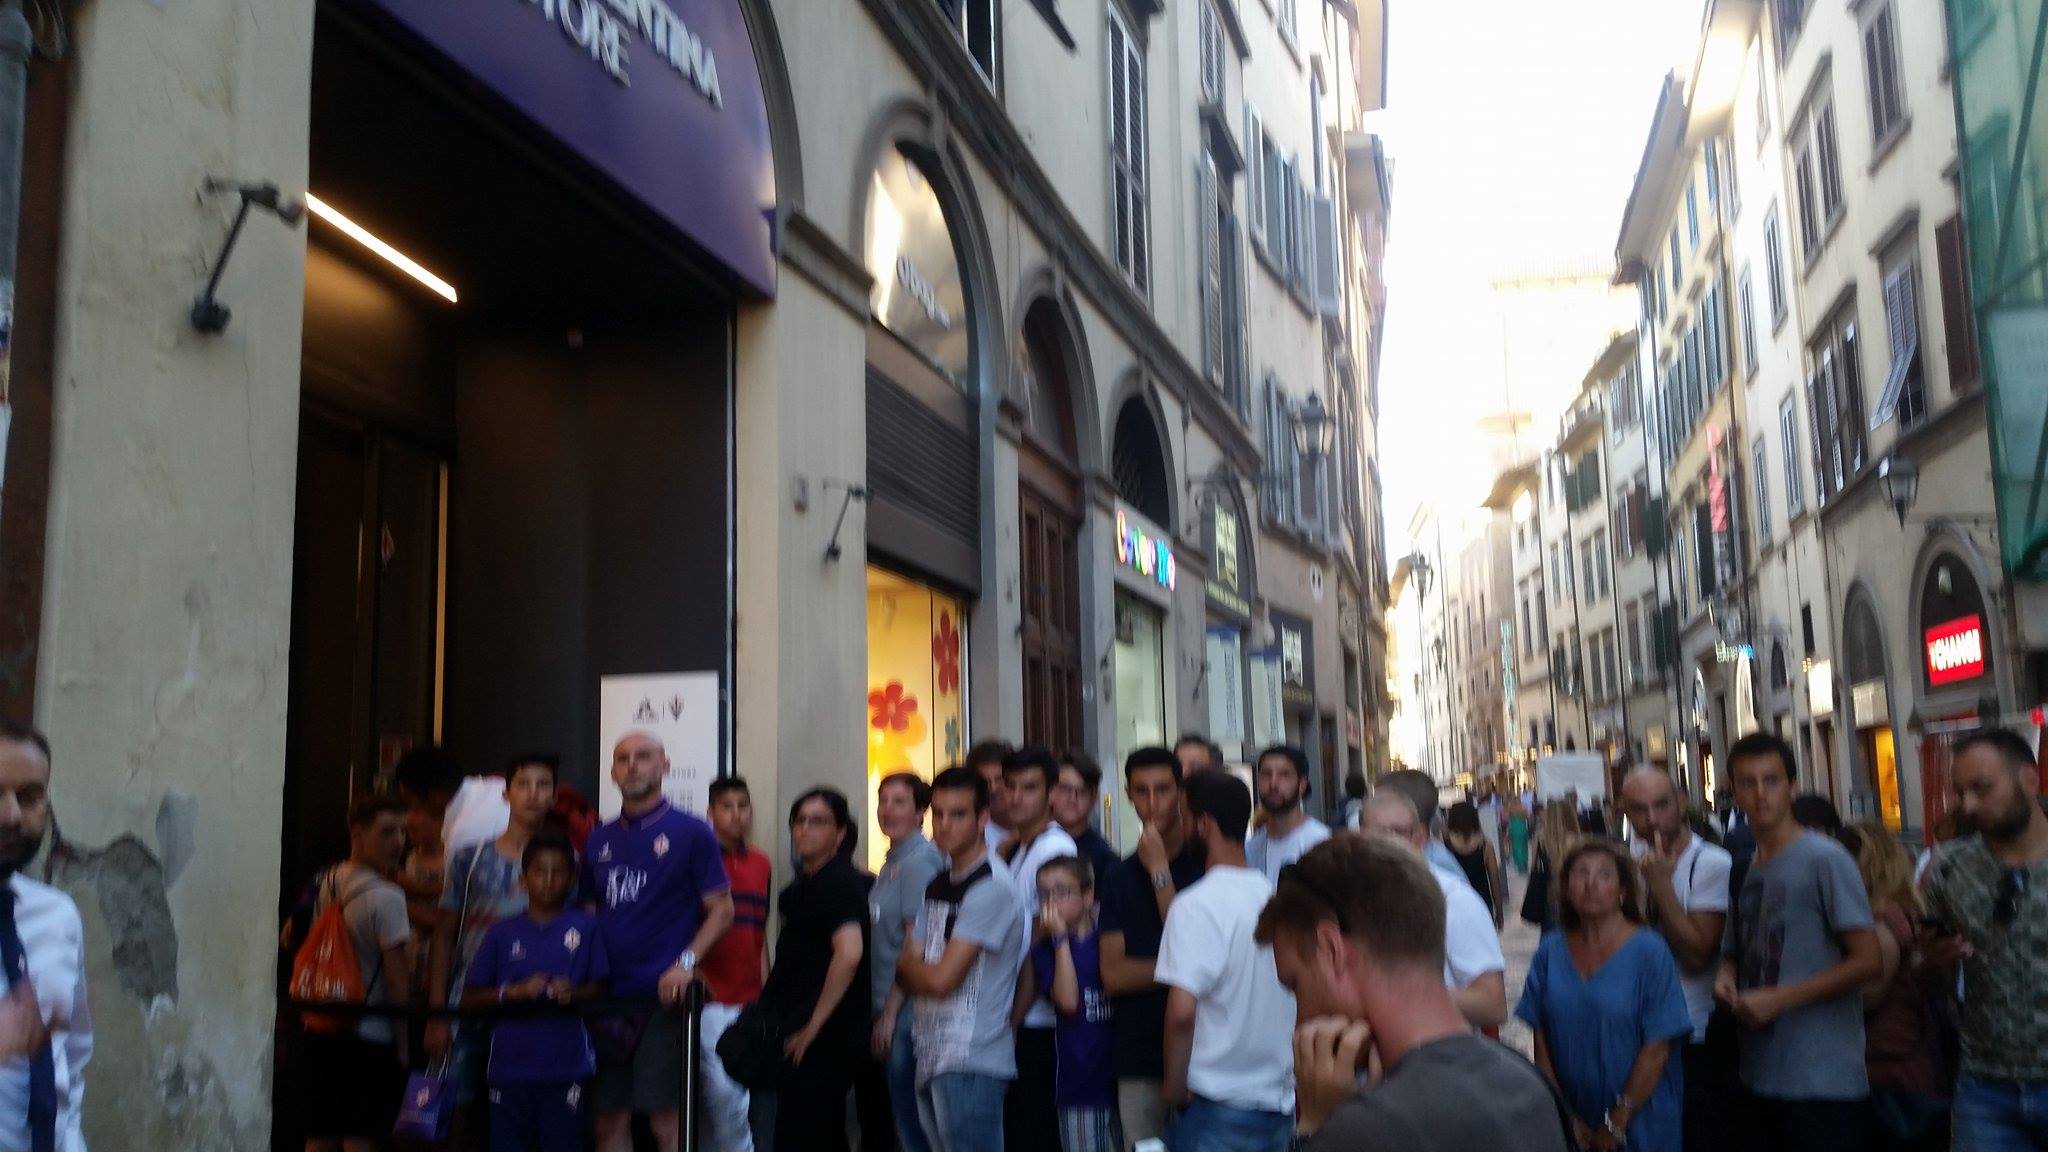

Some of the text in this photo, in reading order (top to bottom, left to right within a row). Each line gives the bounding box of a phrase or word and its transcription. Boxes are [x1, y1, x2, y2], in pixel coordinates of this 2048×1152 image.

[528, 0, 631, 88] ORE
[606, 0, 723, 110] NTINA
[1935, 628, 1982, 672] CHANGE
